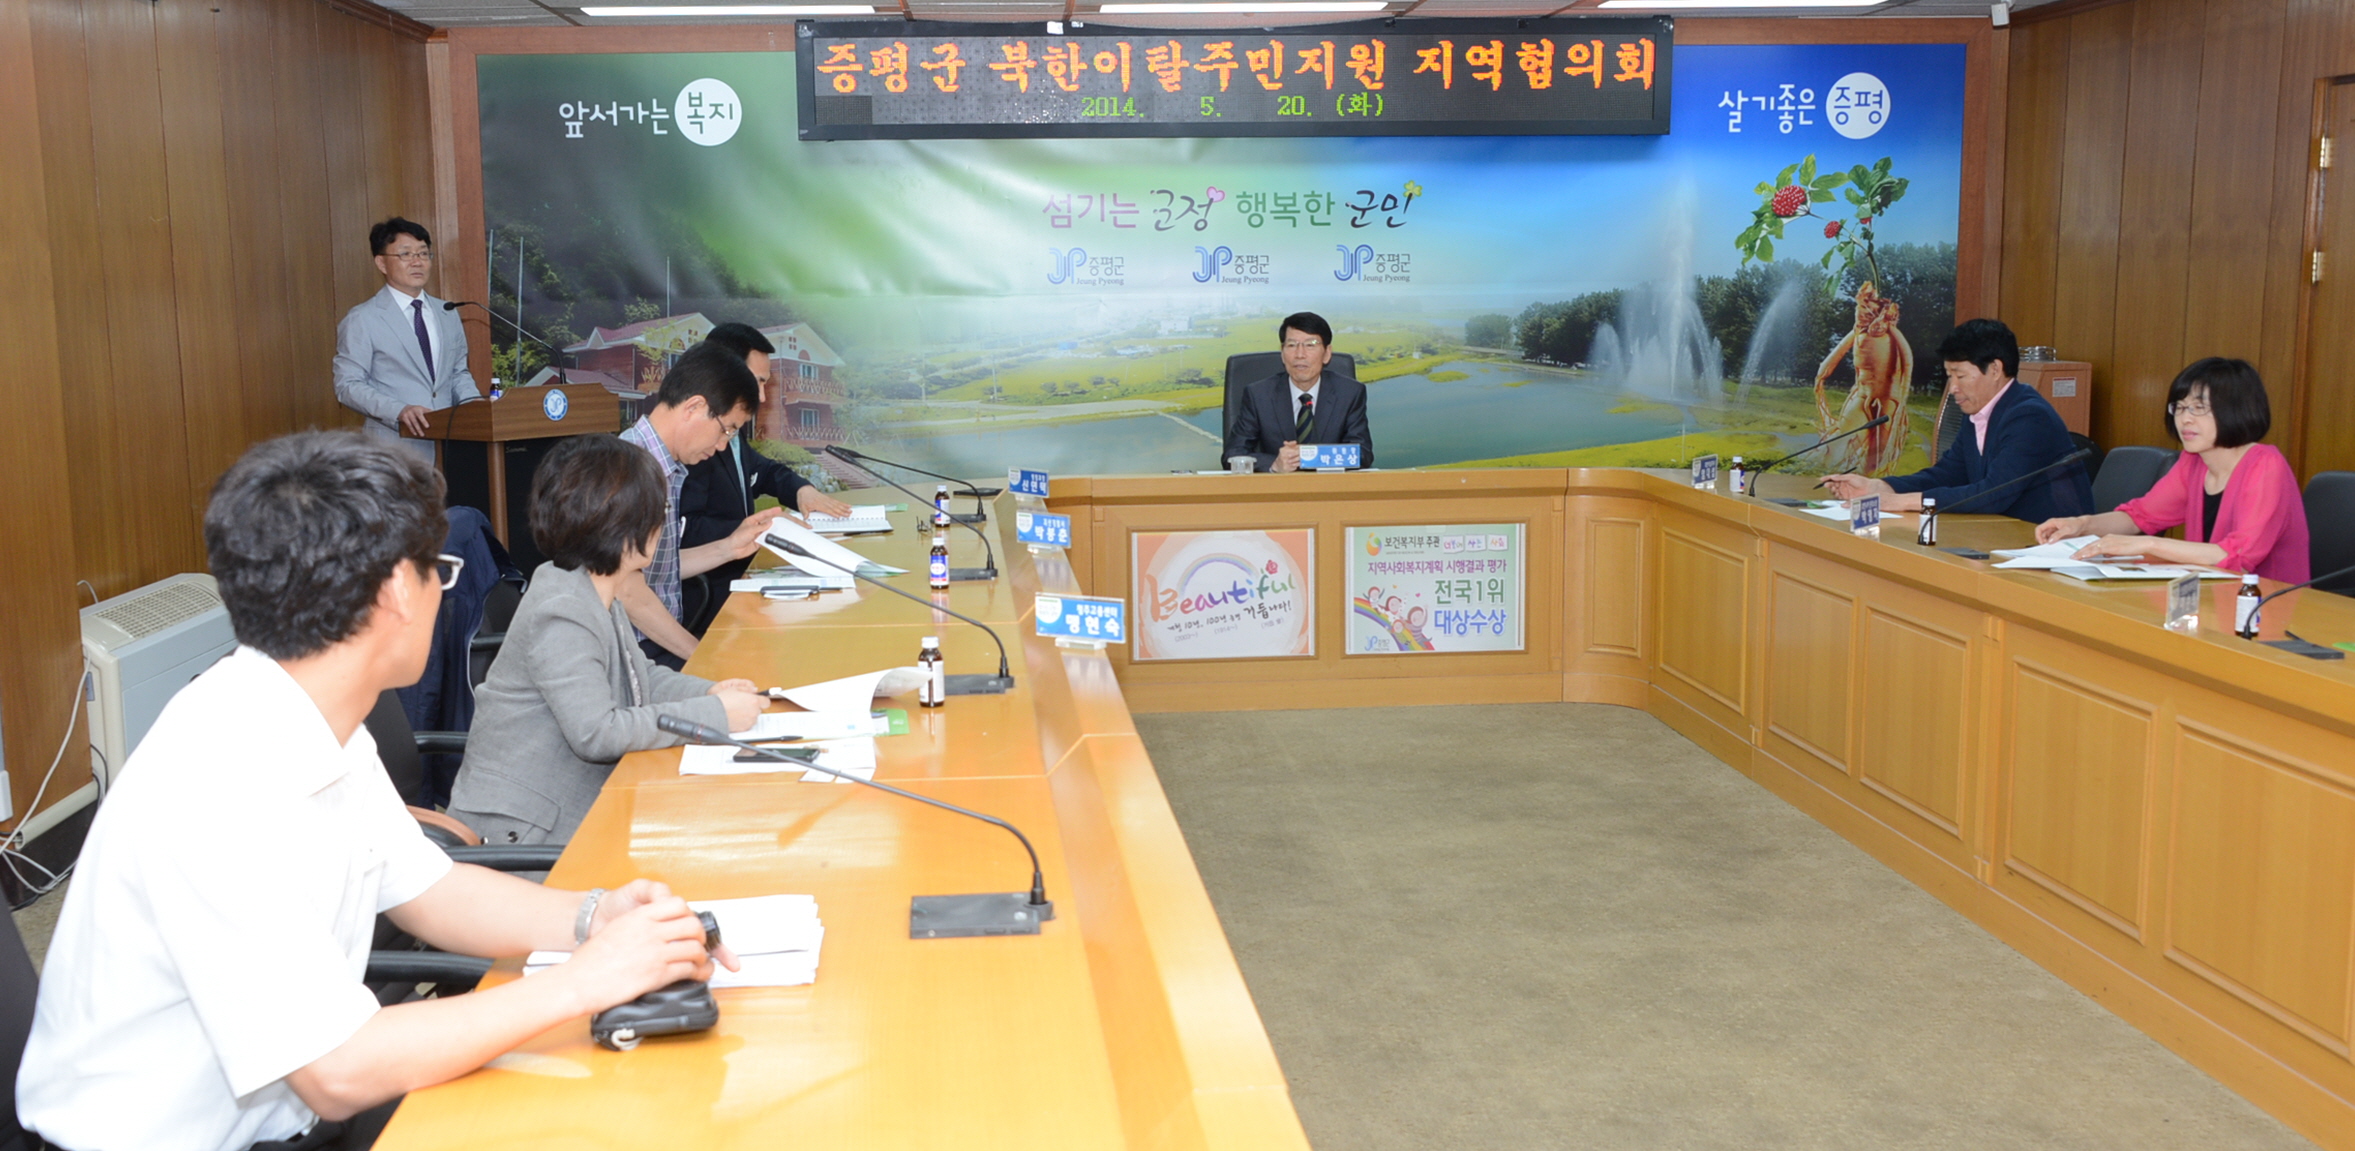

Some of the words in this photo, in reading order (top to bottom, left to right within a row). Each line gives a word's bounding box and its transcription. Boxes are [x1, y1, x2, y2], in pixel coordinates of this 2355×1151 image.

[817, 41, 966, 94] 증평군
[989, 38, 1386, 94] 북한이탈주민지원
[1413, 37, 1656, 92] 지역협의회
[558, 98, 670, 138] 앞서가는
[687, 91, 734, 135] 복지
[1081, 96, 1145, 118] 2014.
[1200, 95, 1222, 118] 5.
[1277, 95, 1313, 117] 20.
[1336, 92, 1384, 117] (화)
[1717, 83, 1816, 134] 살기좋은
[1833, 86, 1884, 126] 증평
[1042, 193, 1140, 229] 섬기는
[1236, 190, 1336, 229] 행복한
[1345, 189, 1413, 229] 군민
[1088, 256, 1125, 276] 증평군
[1234, 255, 1270, 275] 증평군
[1375, 253, 1411, 274] 증평군
[1076, 277, 1097, 286] Jeung
[1098, 277, 1125, 286] Pyeong
[1221, 275, 1242, 284] Jeung
[1243, 275, 1270, 285] Pyeong
[1363, 274, 1384, 283] Jeung
[1384, 274, 1411, 283] Pyeong
[1384, 535, 1425, 549] 보건복지부
[1426, 535, 1440, 548] 주관
[1367, 560, 1444, 576] 지역사회복지계획
[1446, 559, 1485, 574] 시행결과
[1487, 558, 1507, 573] 평가
[1144, 573, 1296, 622] Beautiful
[1434, 578, 1505, 605] 전국1위
[1434, 608, 1507, 635] 대상수상
